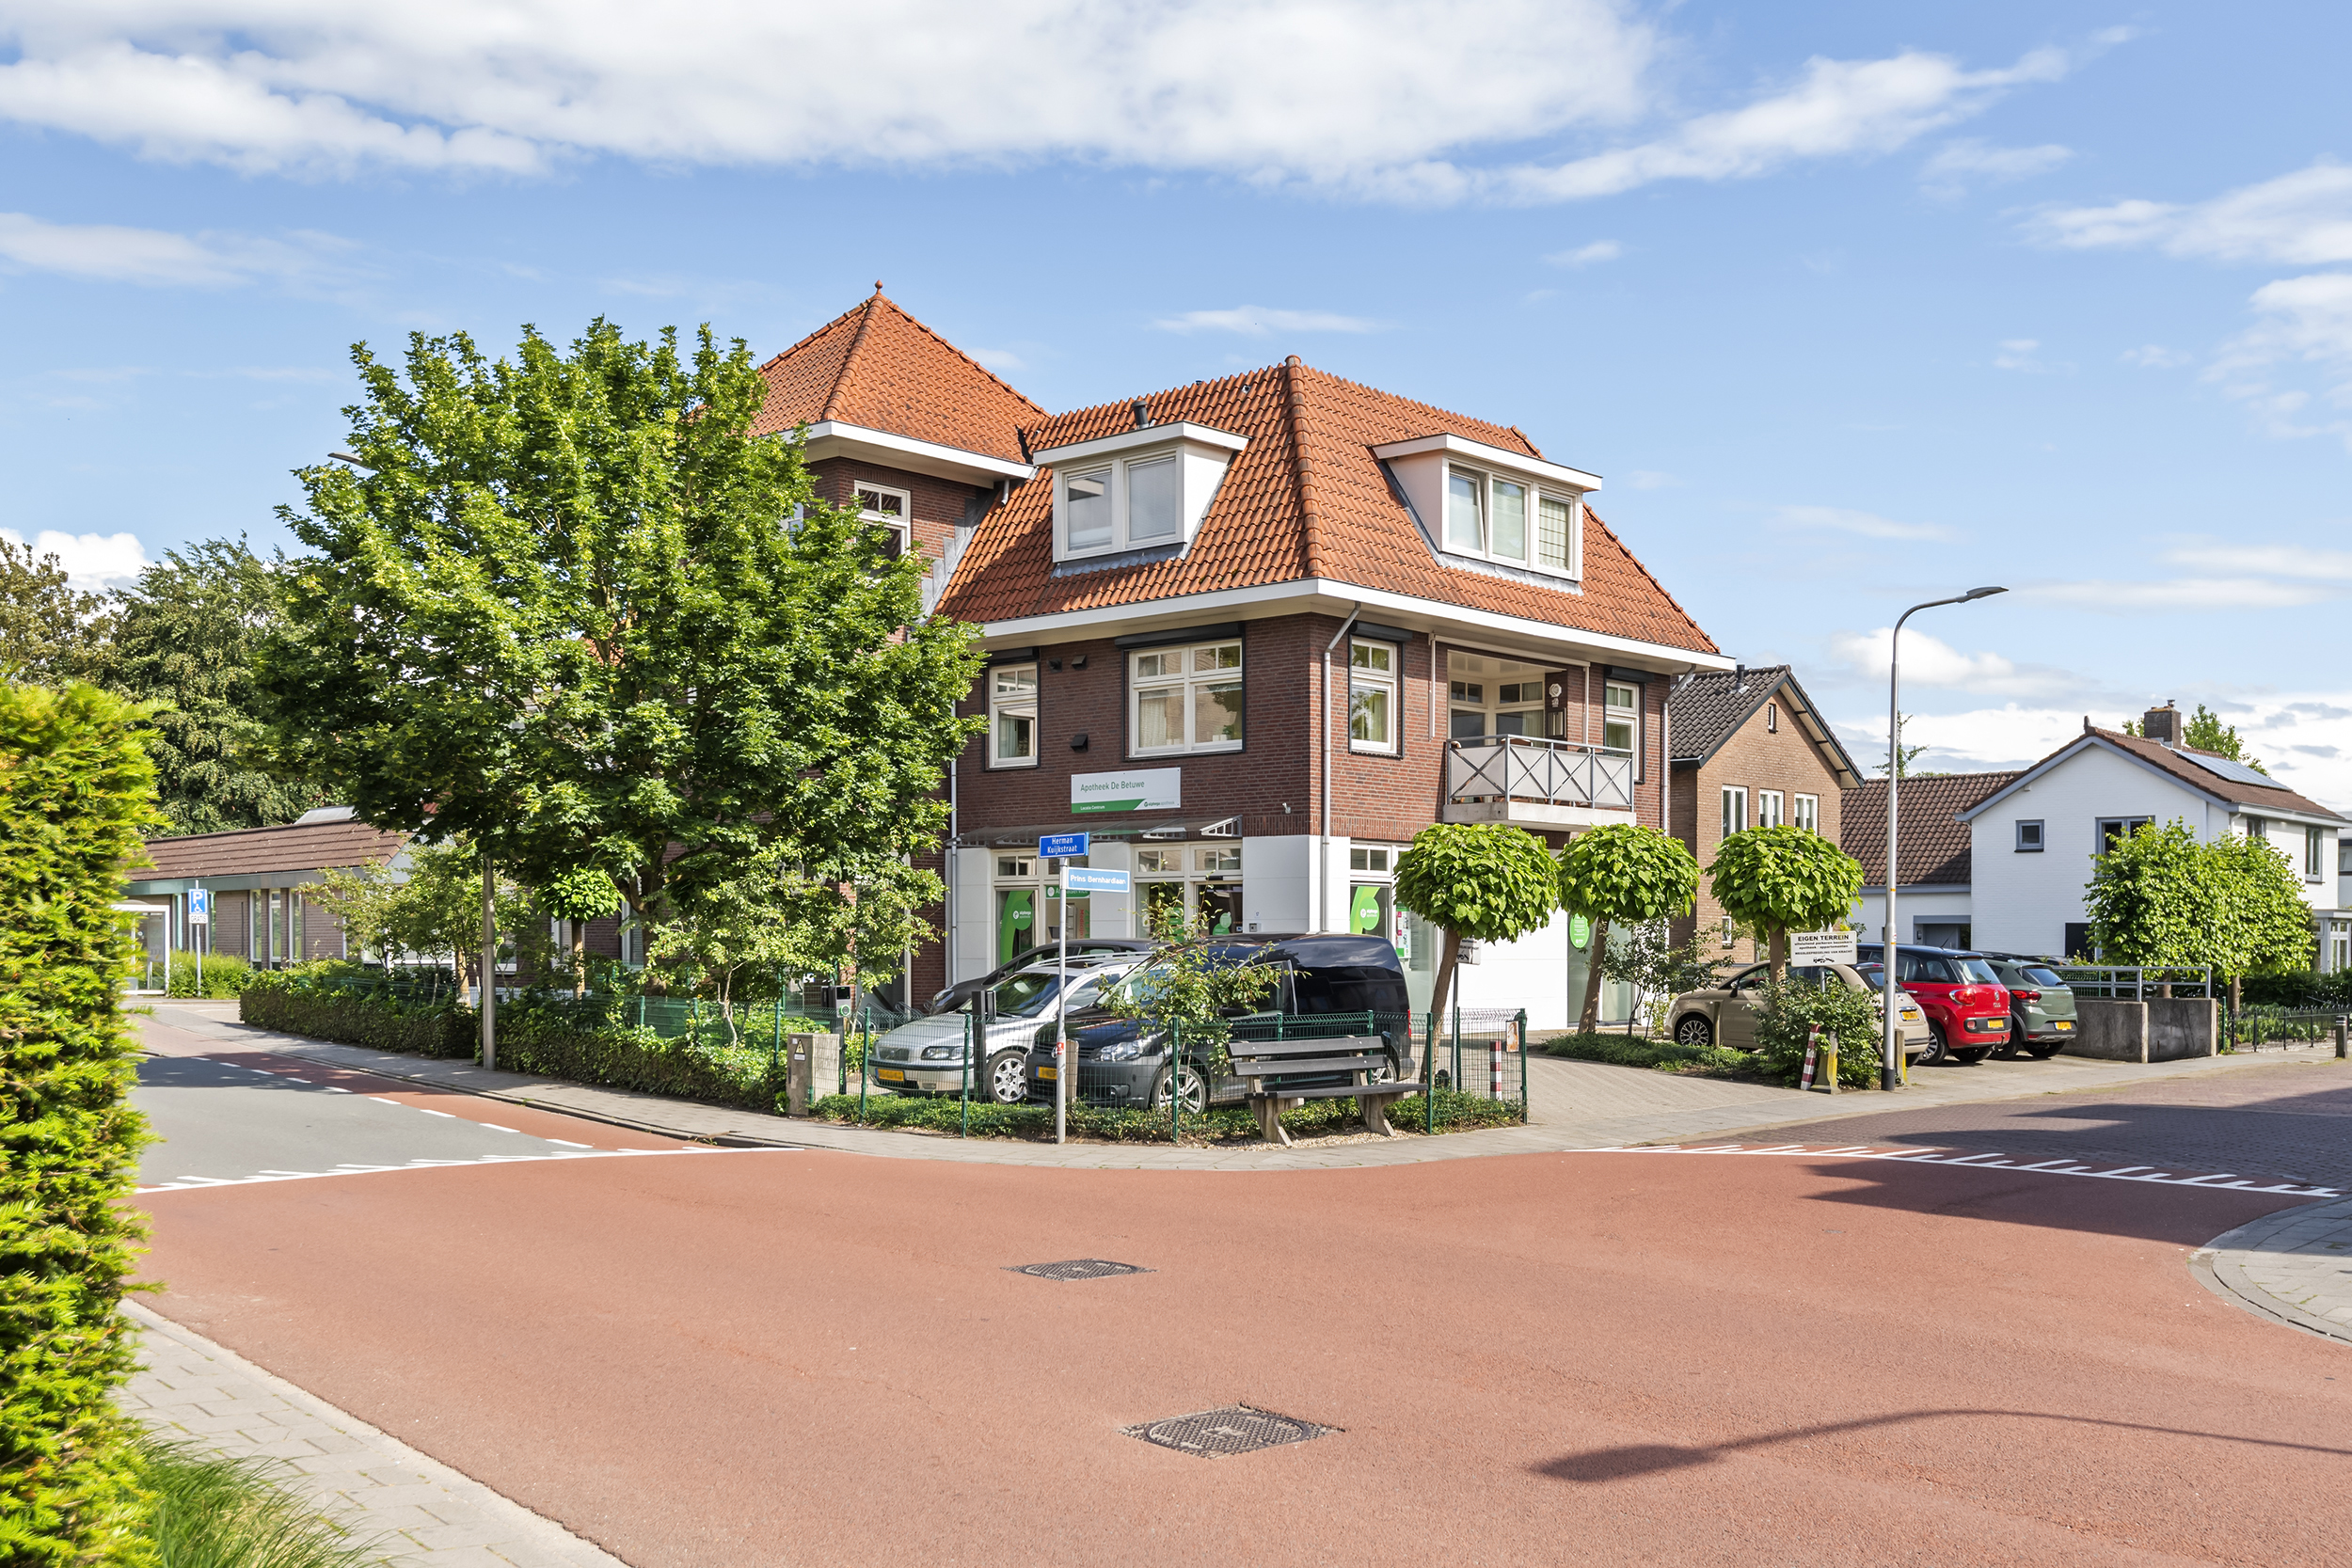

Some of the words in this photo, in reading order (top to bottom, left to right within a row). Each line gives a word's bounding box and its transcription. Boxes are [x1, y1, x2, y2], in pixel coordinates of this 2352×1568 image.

[1080, 783, 1109, 793] Apotheek
[1111, 782, 1120, 790] De
[1120, 781, 1145, 789] Betuwe
[1052, 837, 1073, 846] Herman
[1047, 845, 1078, 855] Kuijkstraat
[1088, 876, 1126, 884] Bernhardlaan
[193, 892, 203, 904] P
